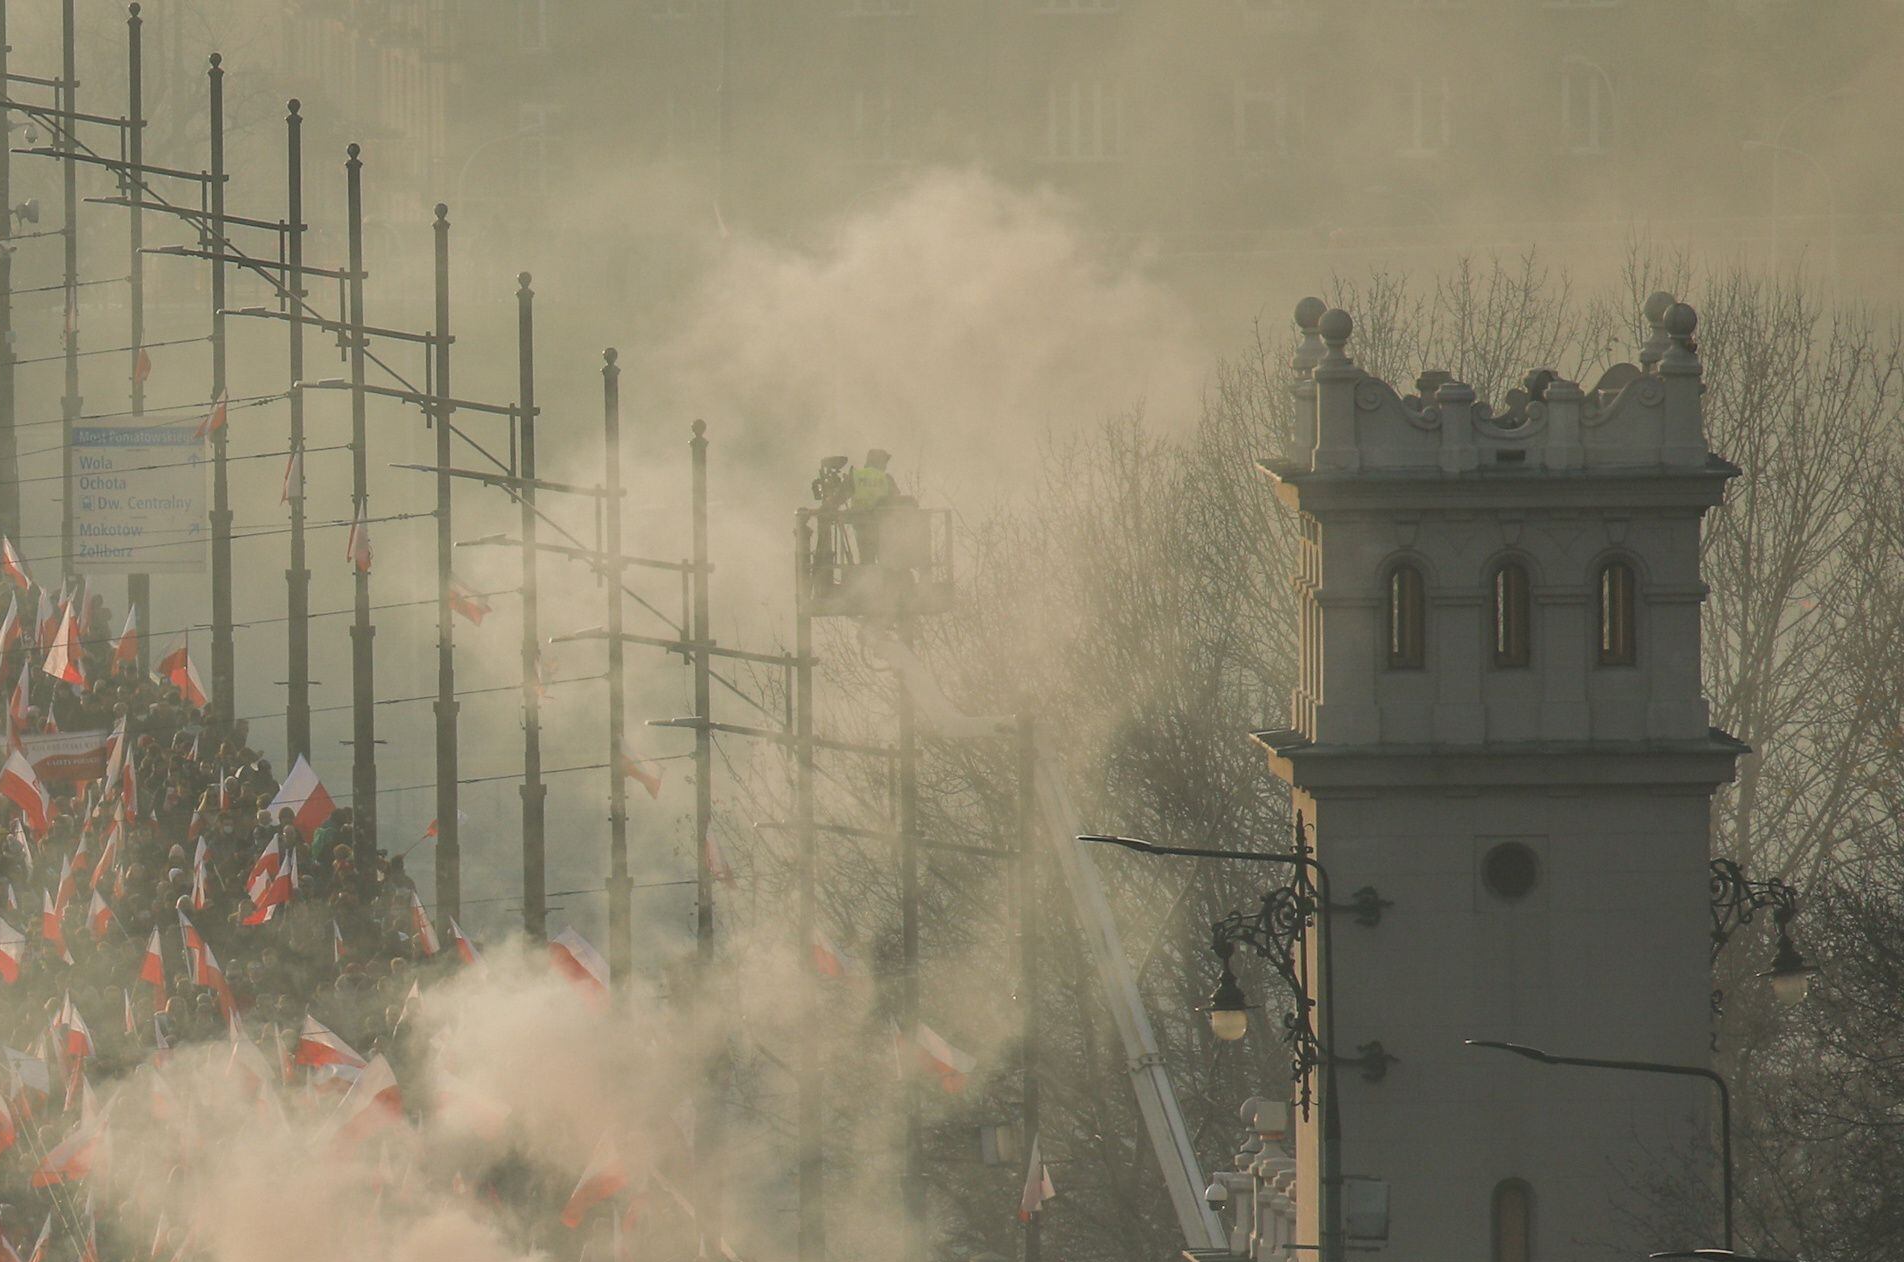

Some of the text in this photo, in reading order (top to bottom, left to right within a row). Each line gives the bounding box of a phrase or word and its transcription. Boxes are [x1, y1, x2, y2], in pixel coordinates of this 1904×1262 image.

[80, 455, 113, 470] Wola
[80, 476, 127, 490] Ochota
[98, 494, 192, 512] Dw. Centralny
